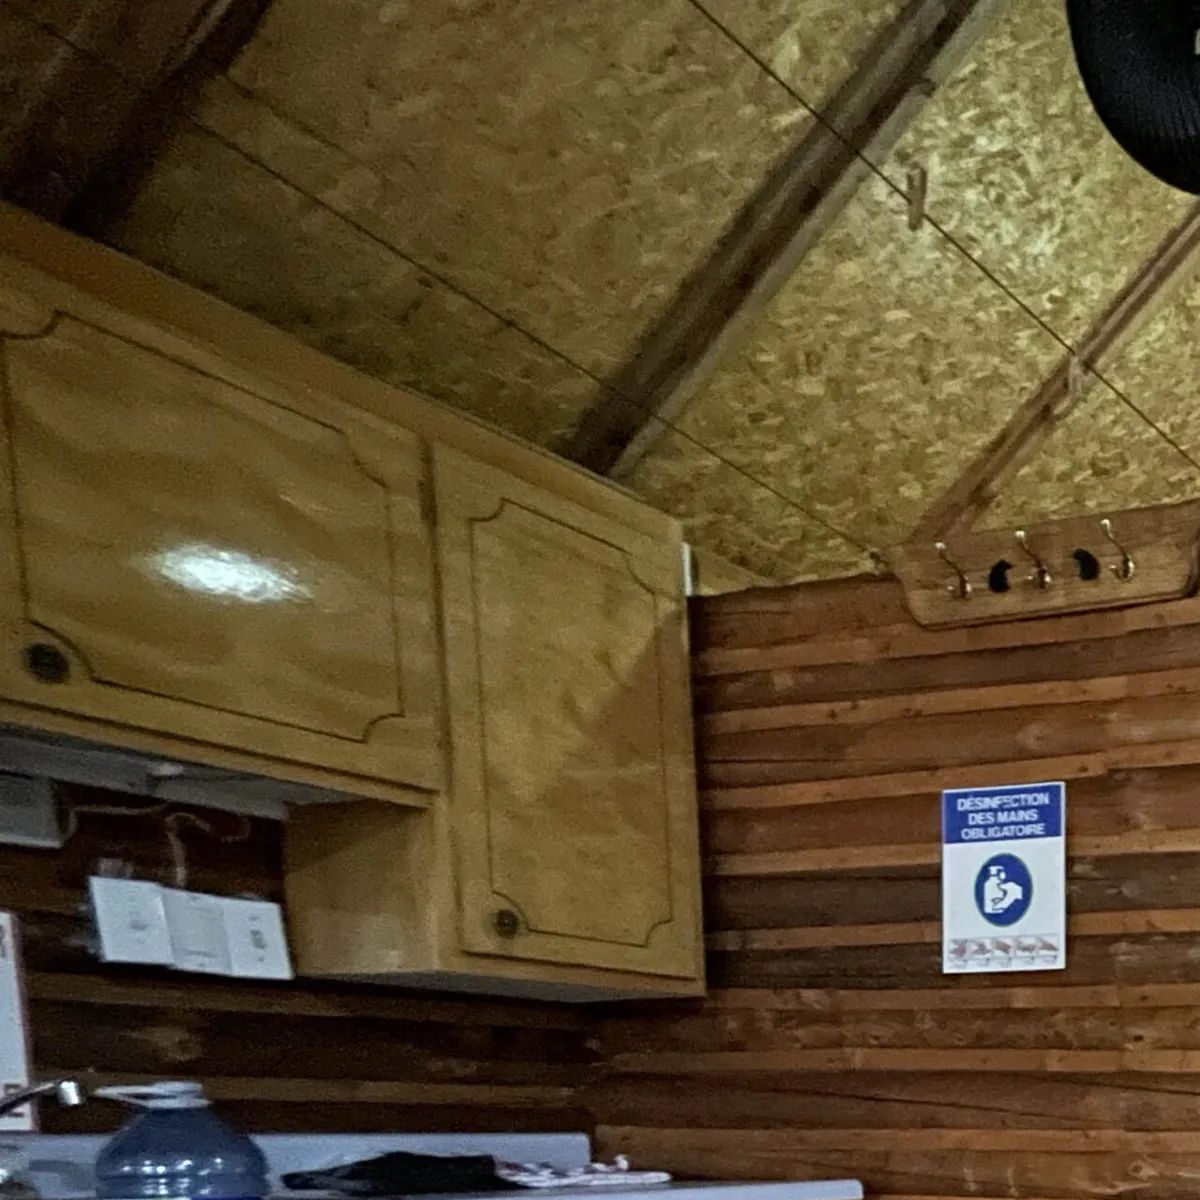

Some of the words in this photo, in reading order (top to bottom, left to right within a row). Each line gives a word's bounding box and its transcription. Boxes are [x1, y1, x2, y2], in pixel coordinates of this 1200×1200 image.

[968, 812, 995, 825] DES
[997, 809, 1038, 823] MAINS
[961, 823, 1046, 840] OBLIGATOIRE
